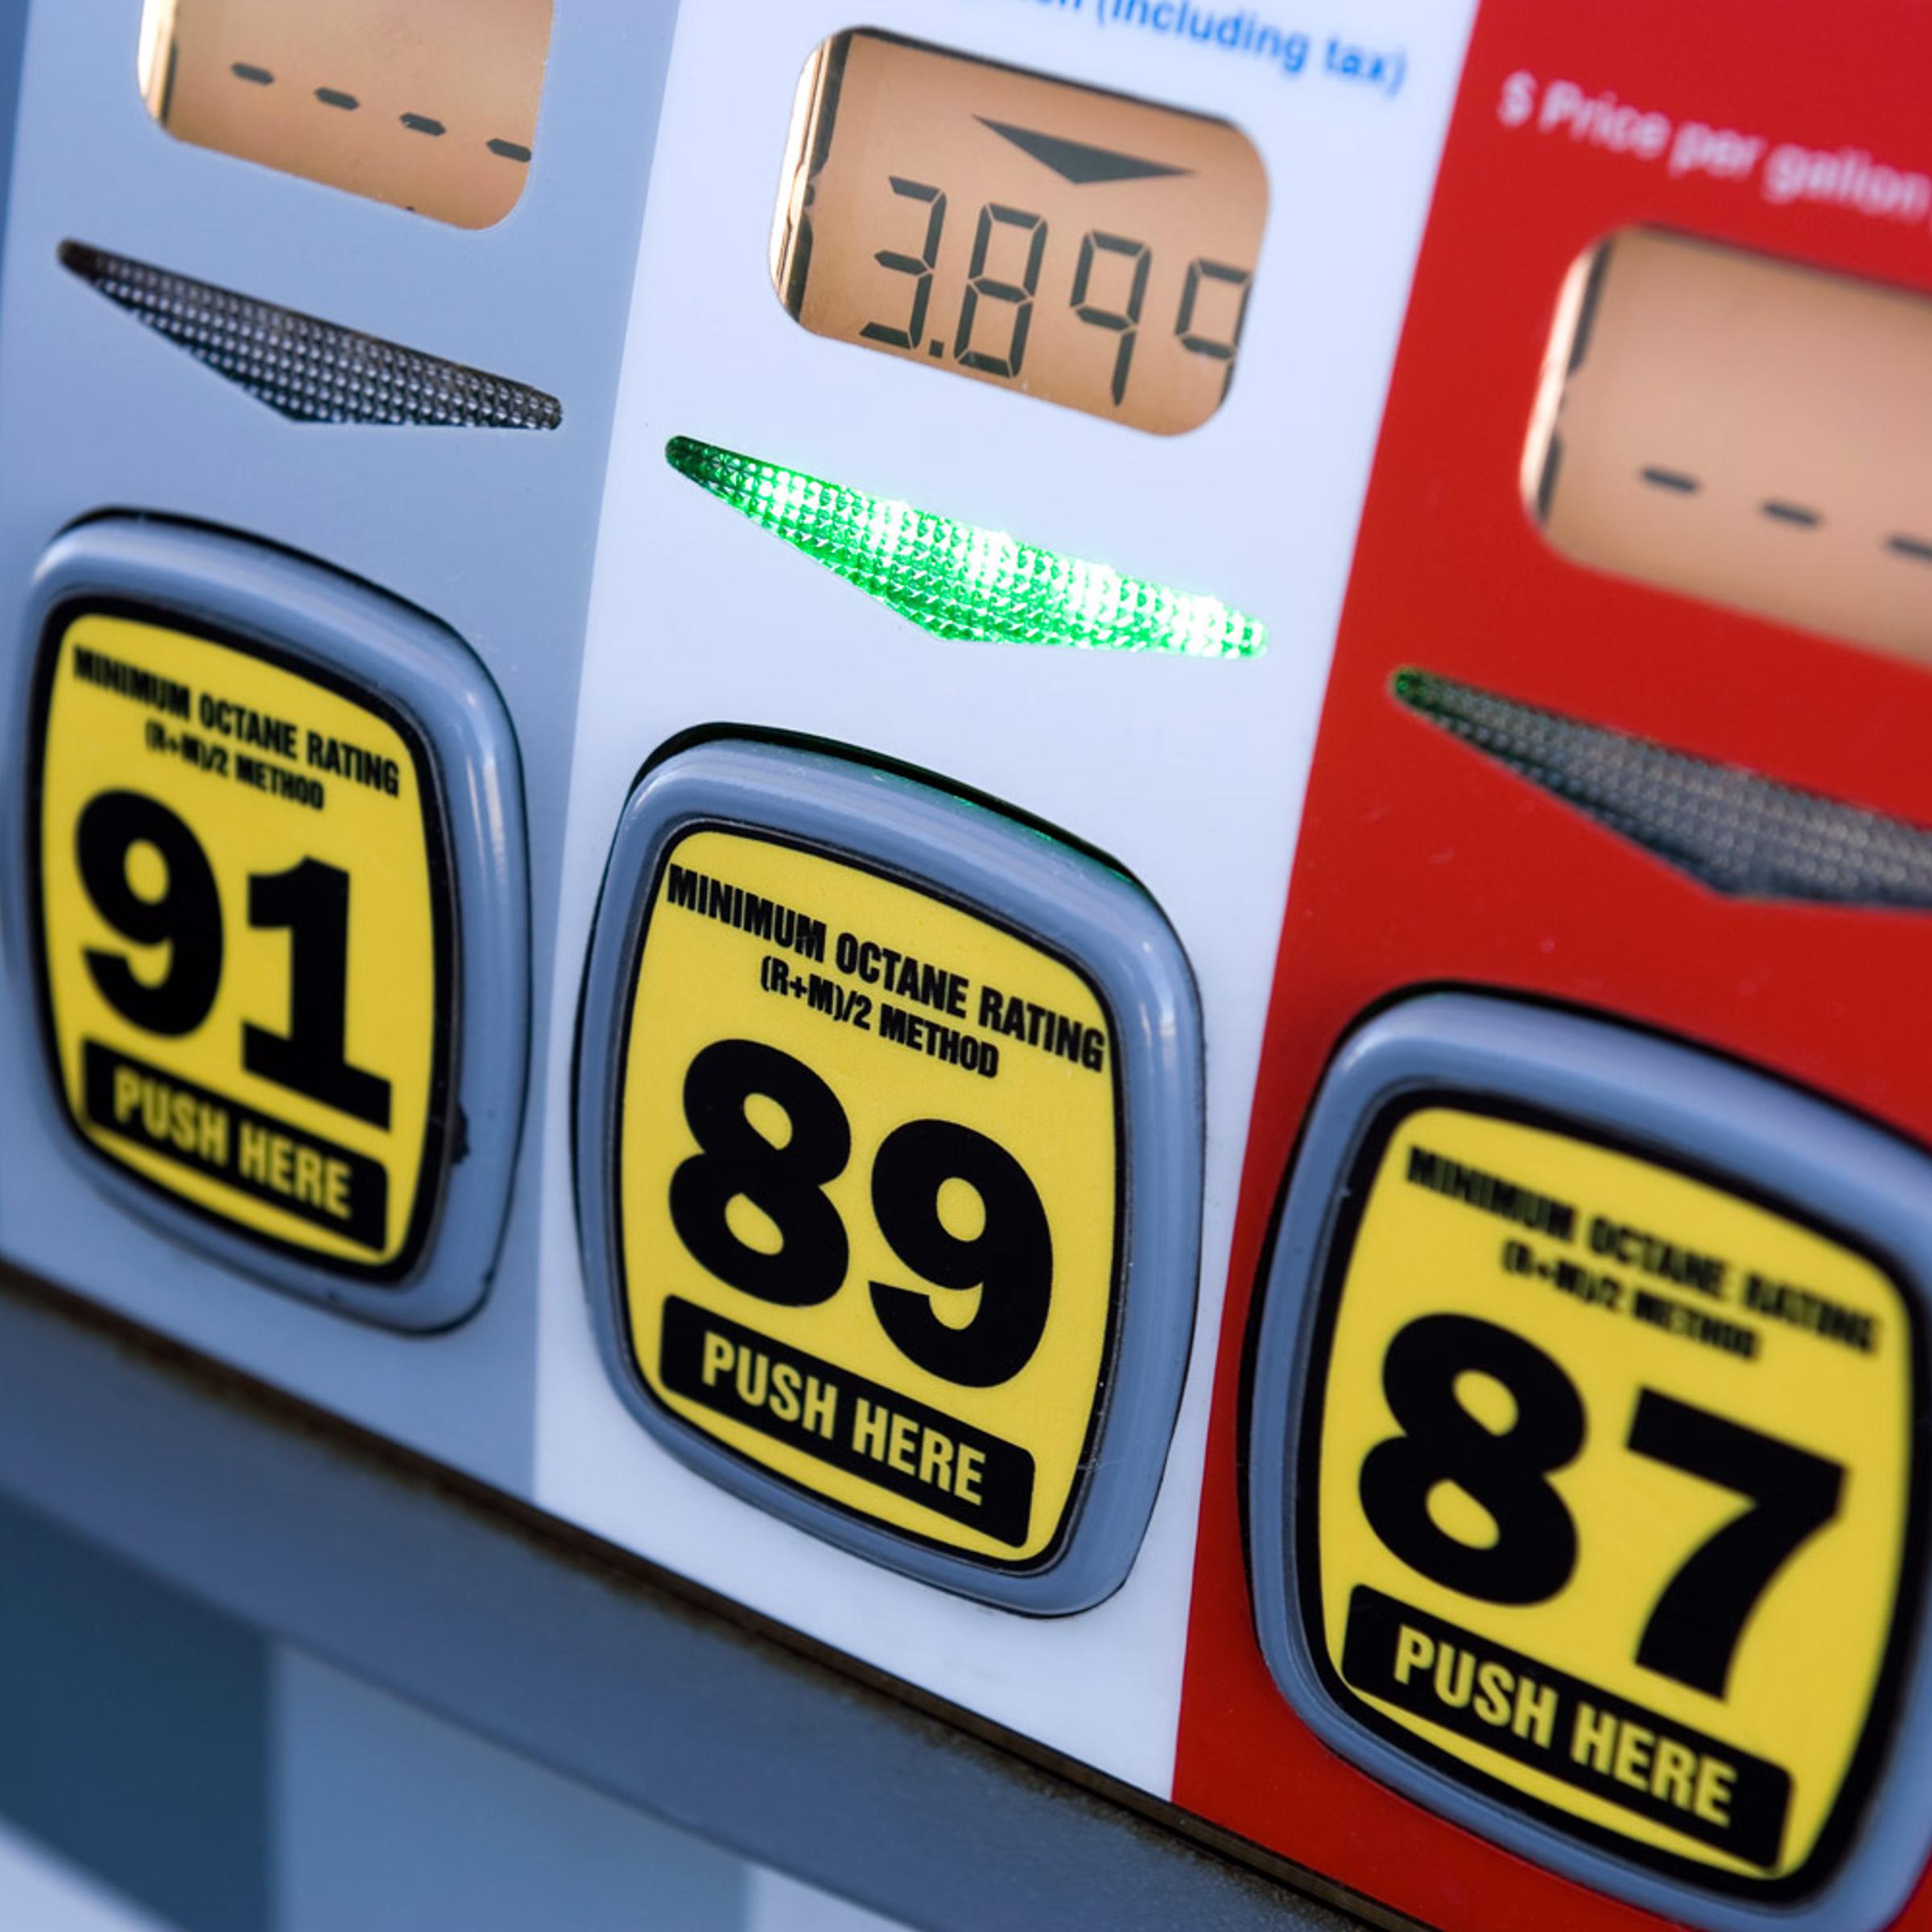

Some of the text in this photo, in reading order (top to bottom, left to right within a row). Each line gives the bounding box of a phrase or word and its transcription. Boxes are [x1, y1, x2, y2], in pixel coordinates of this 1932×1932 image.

[1324, 35, 1408, 98] tax)
[1538, 79, 1670, 159] Price
[1669, 121, 1765, 178] per
[1762, 143, 1931, 222] gallon
[73, 646, 400, 798] MINIMUM OCTANE RATING
[145, 718, 324, 811] (R+M)/2 METHOD
[74, 789, 392, 1135] 91
[667, 863, 1105, 1072] MINIMUM OCTANE RATING
[760, 955, 999, 1079] (R+M)/2 METHOD
[114, 1065, 351, 1220] PUSH HERE
[669, 1038, 1054, 1389] 89
[1406, 1145, 1881, 1356] MINIMUM OCTANE RATING
[1632, 1289, 1761, 1362] METHOD
[702, 1331, 986, 1506] PUSH HERE
[1359, 1313, 1849, 1705] 87
[1393, 1623, 1738, 1828] PUSH HERE
